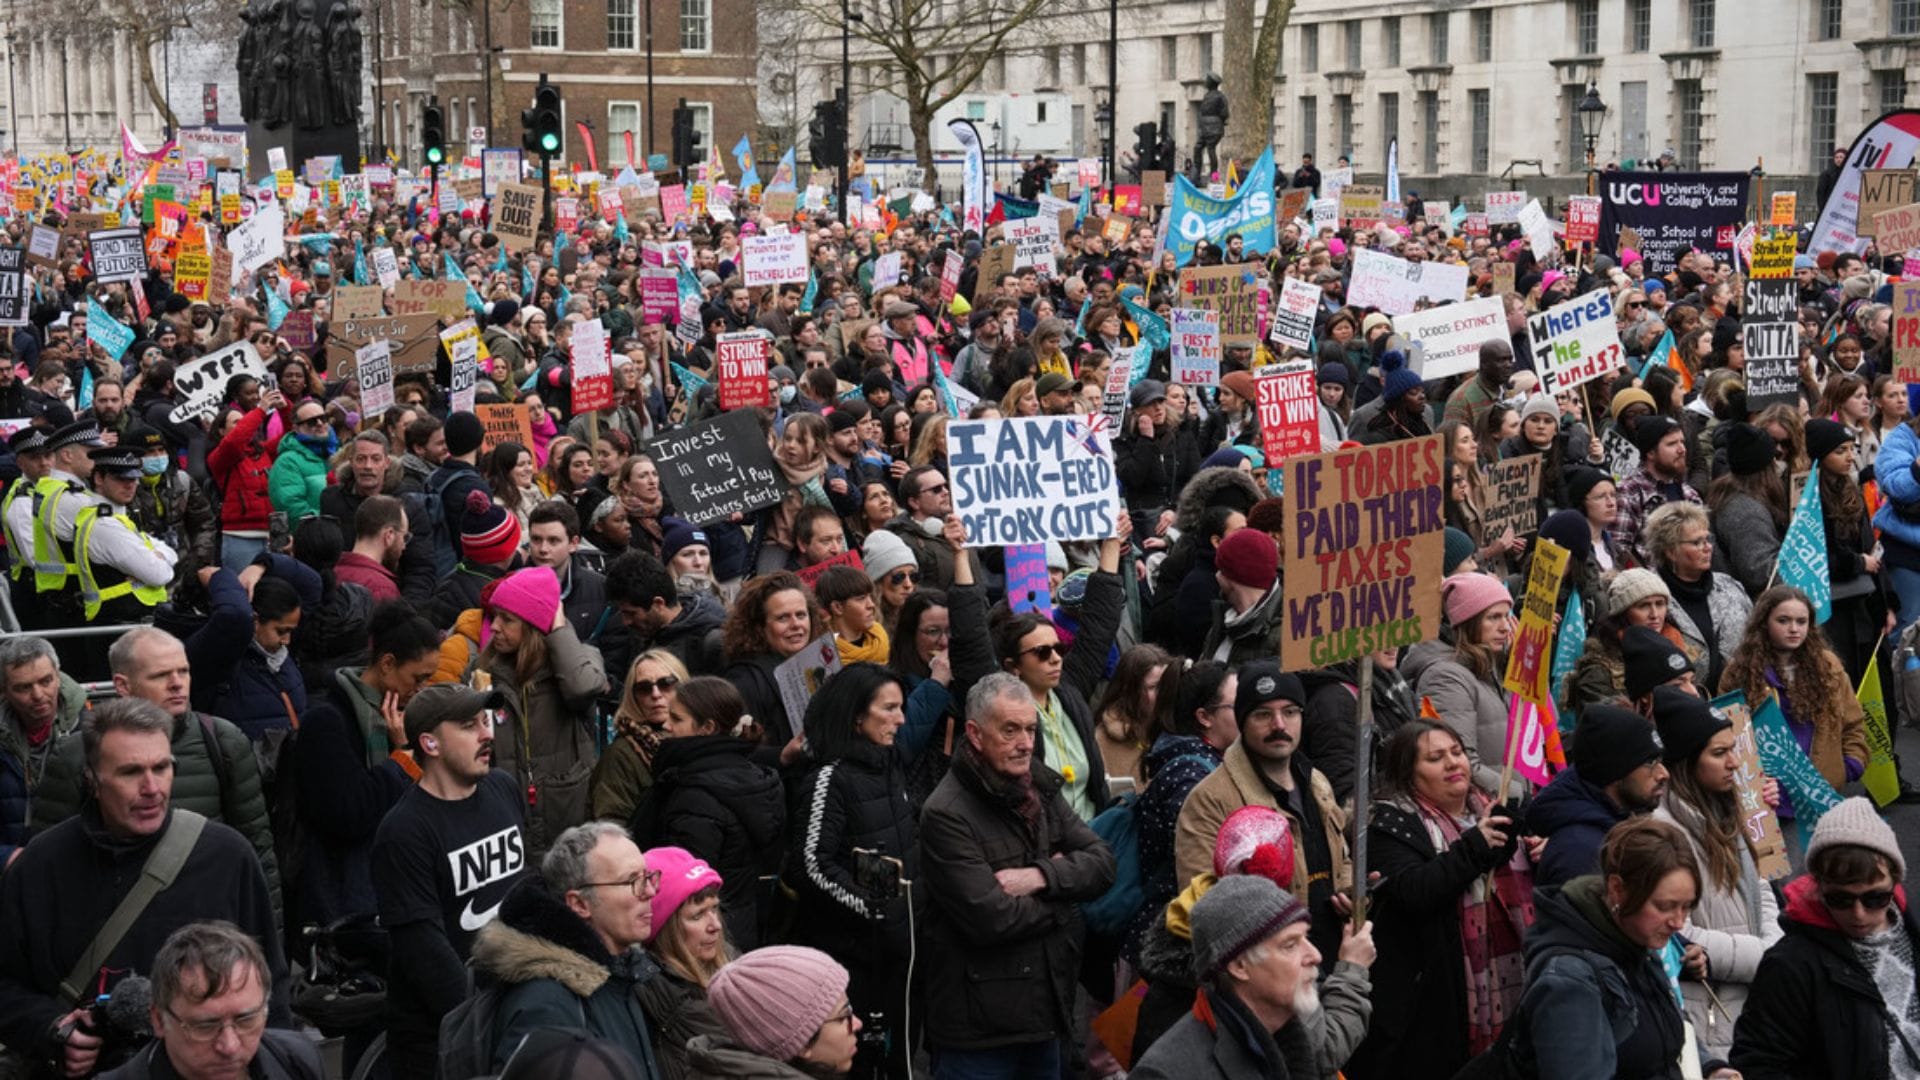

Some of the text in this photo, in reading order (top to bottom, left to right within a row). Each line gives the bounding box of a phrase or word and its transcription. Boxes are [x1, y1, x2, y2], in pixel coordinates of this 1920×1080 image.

[502, 189, 536, 210] SAVE
[1609, 182, 1661, 206] UCU
[1660, 182, 1738, 199] University and
[1569, 200, 1600, 213] STRIKE
[1665, 195, 1738, 209] College Union
[501, 206, 532, 227] OUR
[1180, 190, 1271, 241] Oasis
[1569, 212, 1599, 224] TO WIN
[1874, 210, 1912, 234] FUND
[495, 222, 533, 239] SCHOOLS
[1012, 225, 1041, 238] TEACH
[1027, 233, 1050, 244] THEIR
[1661, 225, 1697, 238] School
[1701, 226, 1713, 238] of
[94, 238, 142, 256] FUND THE
[1016, 244, 1051, 258] UTURES
[1754, 241, 1794, 256] Strike for
[96, 256, 144, 273] FUTURE
[1752, 255, 1793, 269] education
[787, 266, 806, 279] LAST
[410, 281, 447, 298] FOR
[643, 288, 678, 300] Refugees
[394, 299, 427, 314] THE
[644, 299, 677, 308] welcome
[1746, 280, 1798, 322] Straight
[1454, 313, 1497, 333] EXTINCT
[1530, 291, 1612, 344] Where's
[1182, 333, 1213, 347] FIRST
[1745, 323, 1795, 358] OUTTA
[720, 340, 765, 361] STRIKE
[1202, 346, 1219, 359] PUT
[1537, 338, 1582, 370] The
[176, 348, 250, 395] WTF?
[721, 358, 767, 379] TO WIN
[1181, 369, 1213, 383] LAST
[1543, 343, 1620, 394] Funds?
[361, 369, 391, 389] OUT!
[1258, 373, 1313, 404] STRIKE
[1259, 398, 1316, 428] TO WIN
[651, 424, 726, 462] Invest
[949, 418, 1065, 467] I AM
[1265, 427, 1301, 441] We all need
[1272, 441, 1284, 452] pay
[1285, 439, 1298, 449] rise
[676, 451, 733, 477] in my
[749, 467, 775, 485] Pay
[955, 455, 1111, 509] SUNAK-ERED
[1295, 438, 1443, 511] IF TORIES
[684, 486, 785, 525] teachers fairly.
[1050, 499, 1113, 540] CUTS
[1296, 485, 1444, 560] PAID THEIR
[1316, 537, 1413, 593] TAXES
[1289, 575, 1416, 642] WE'D HAVE
[457, 828, 523, 892] NHS
